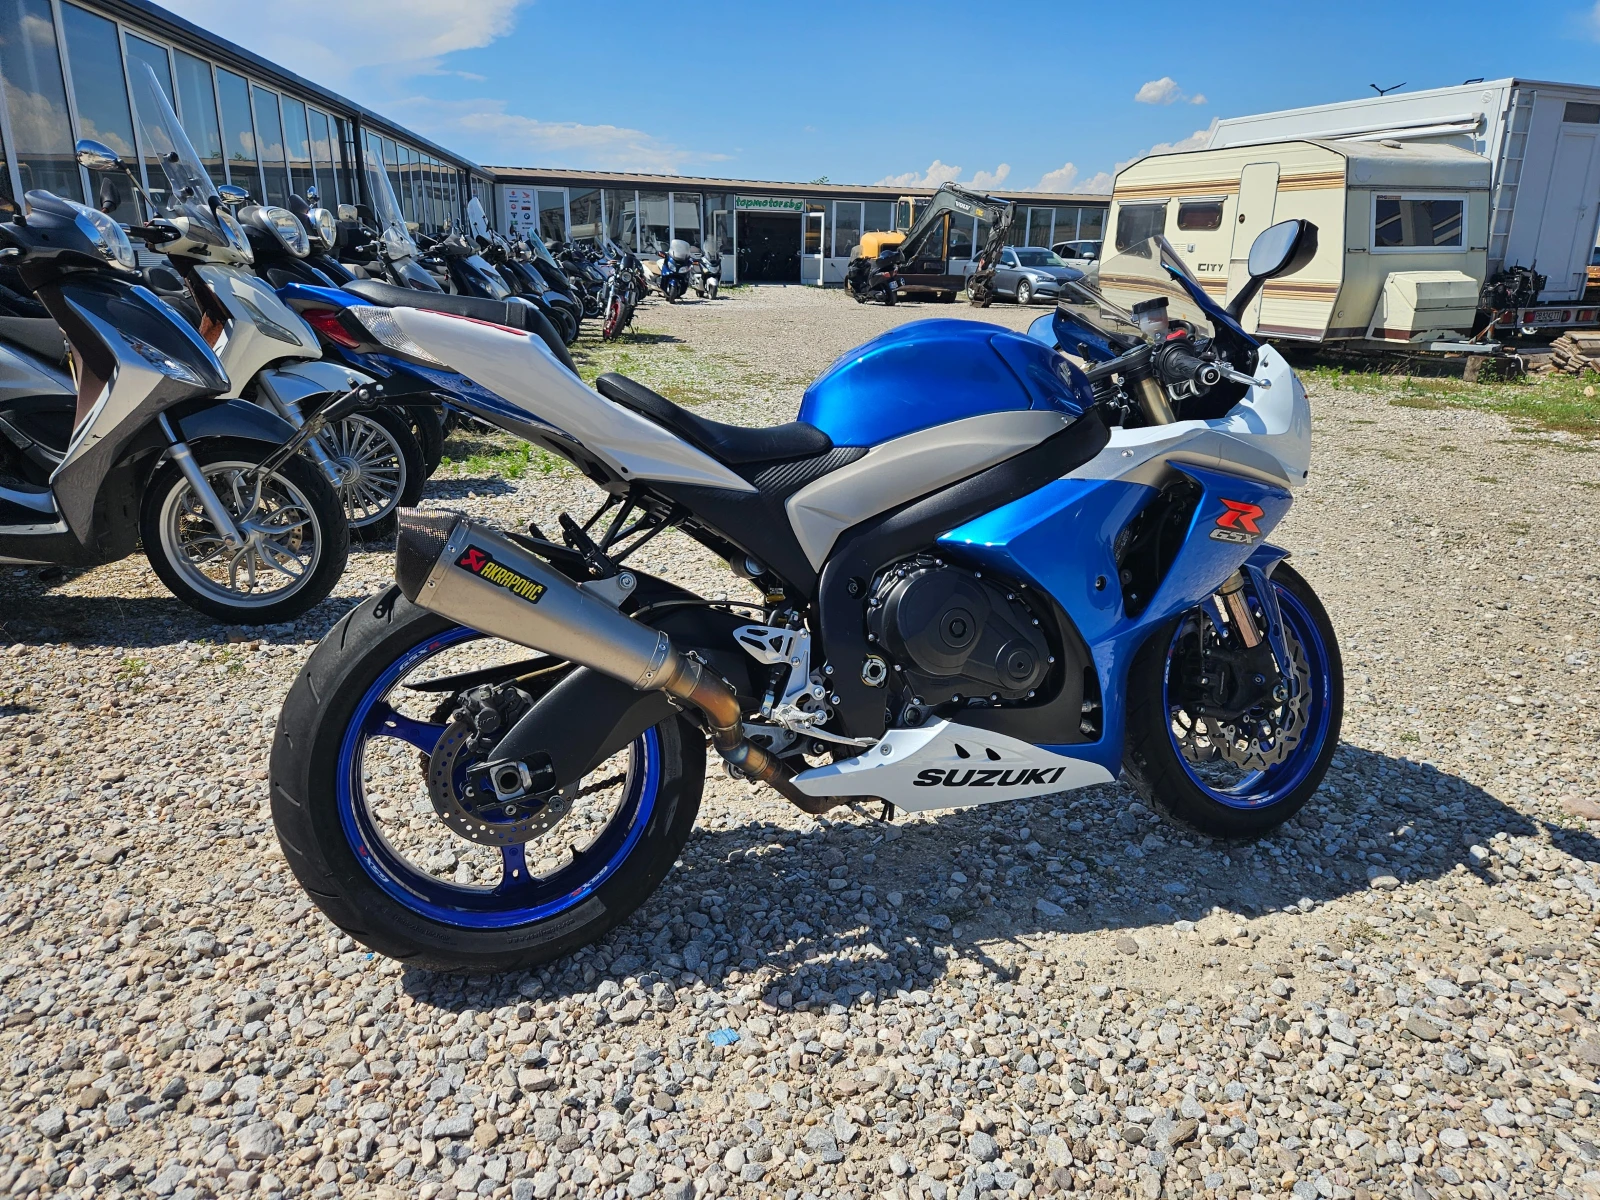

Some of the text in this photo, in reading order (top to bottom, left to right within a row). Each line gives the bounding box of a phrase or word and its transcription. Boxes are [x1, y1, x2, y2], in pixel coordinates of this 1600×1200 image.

[1197, 263, 1224, 271] CITY
[1215, 497, 1265, 534] R
[1209, 528, 1258, 544] GSX
[912, 766, 1067, 787] SUZUKI
